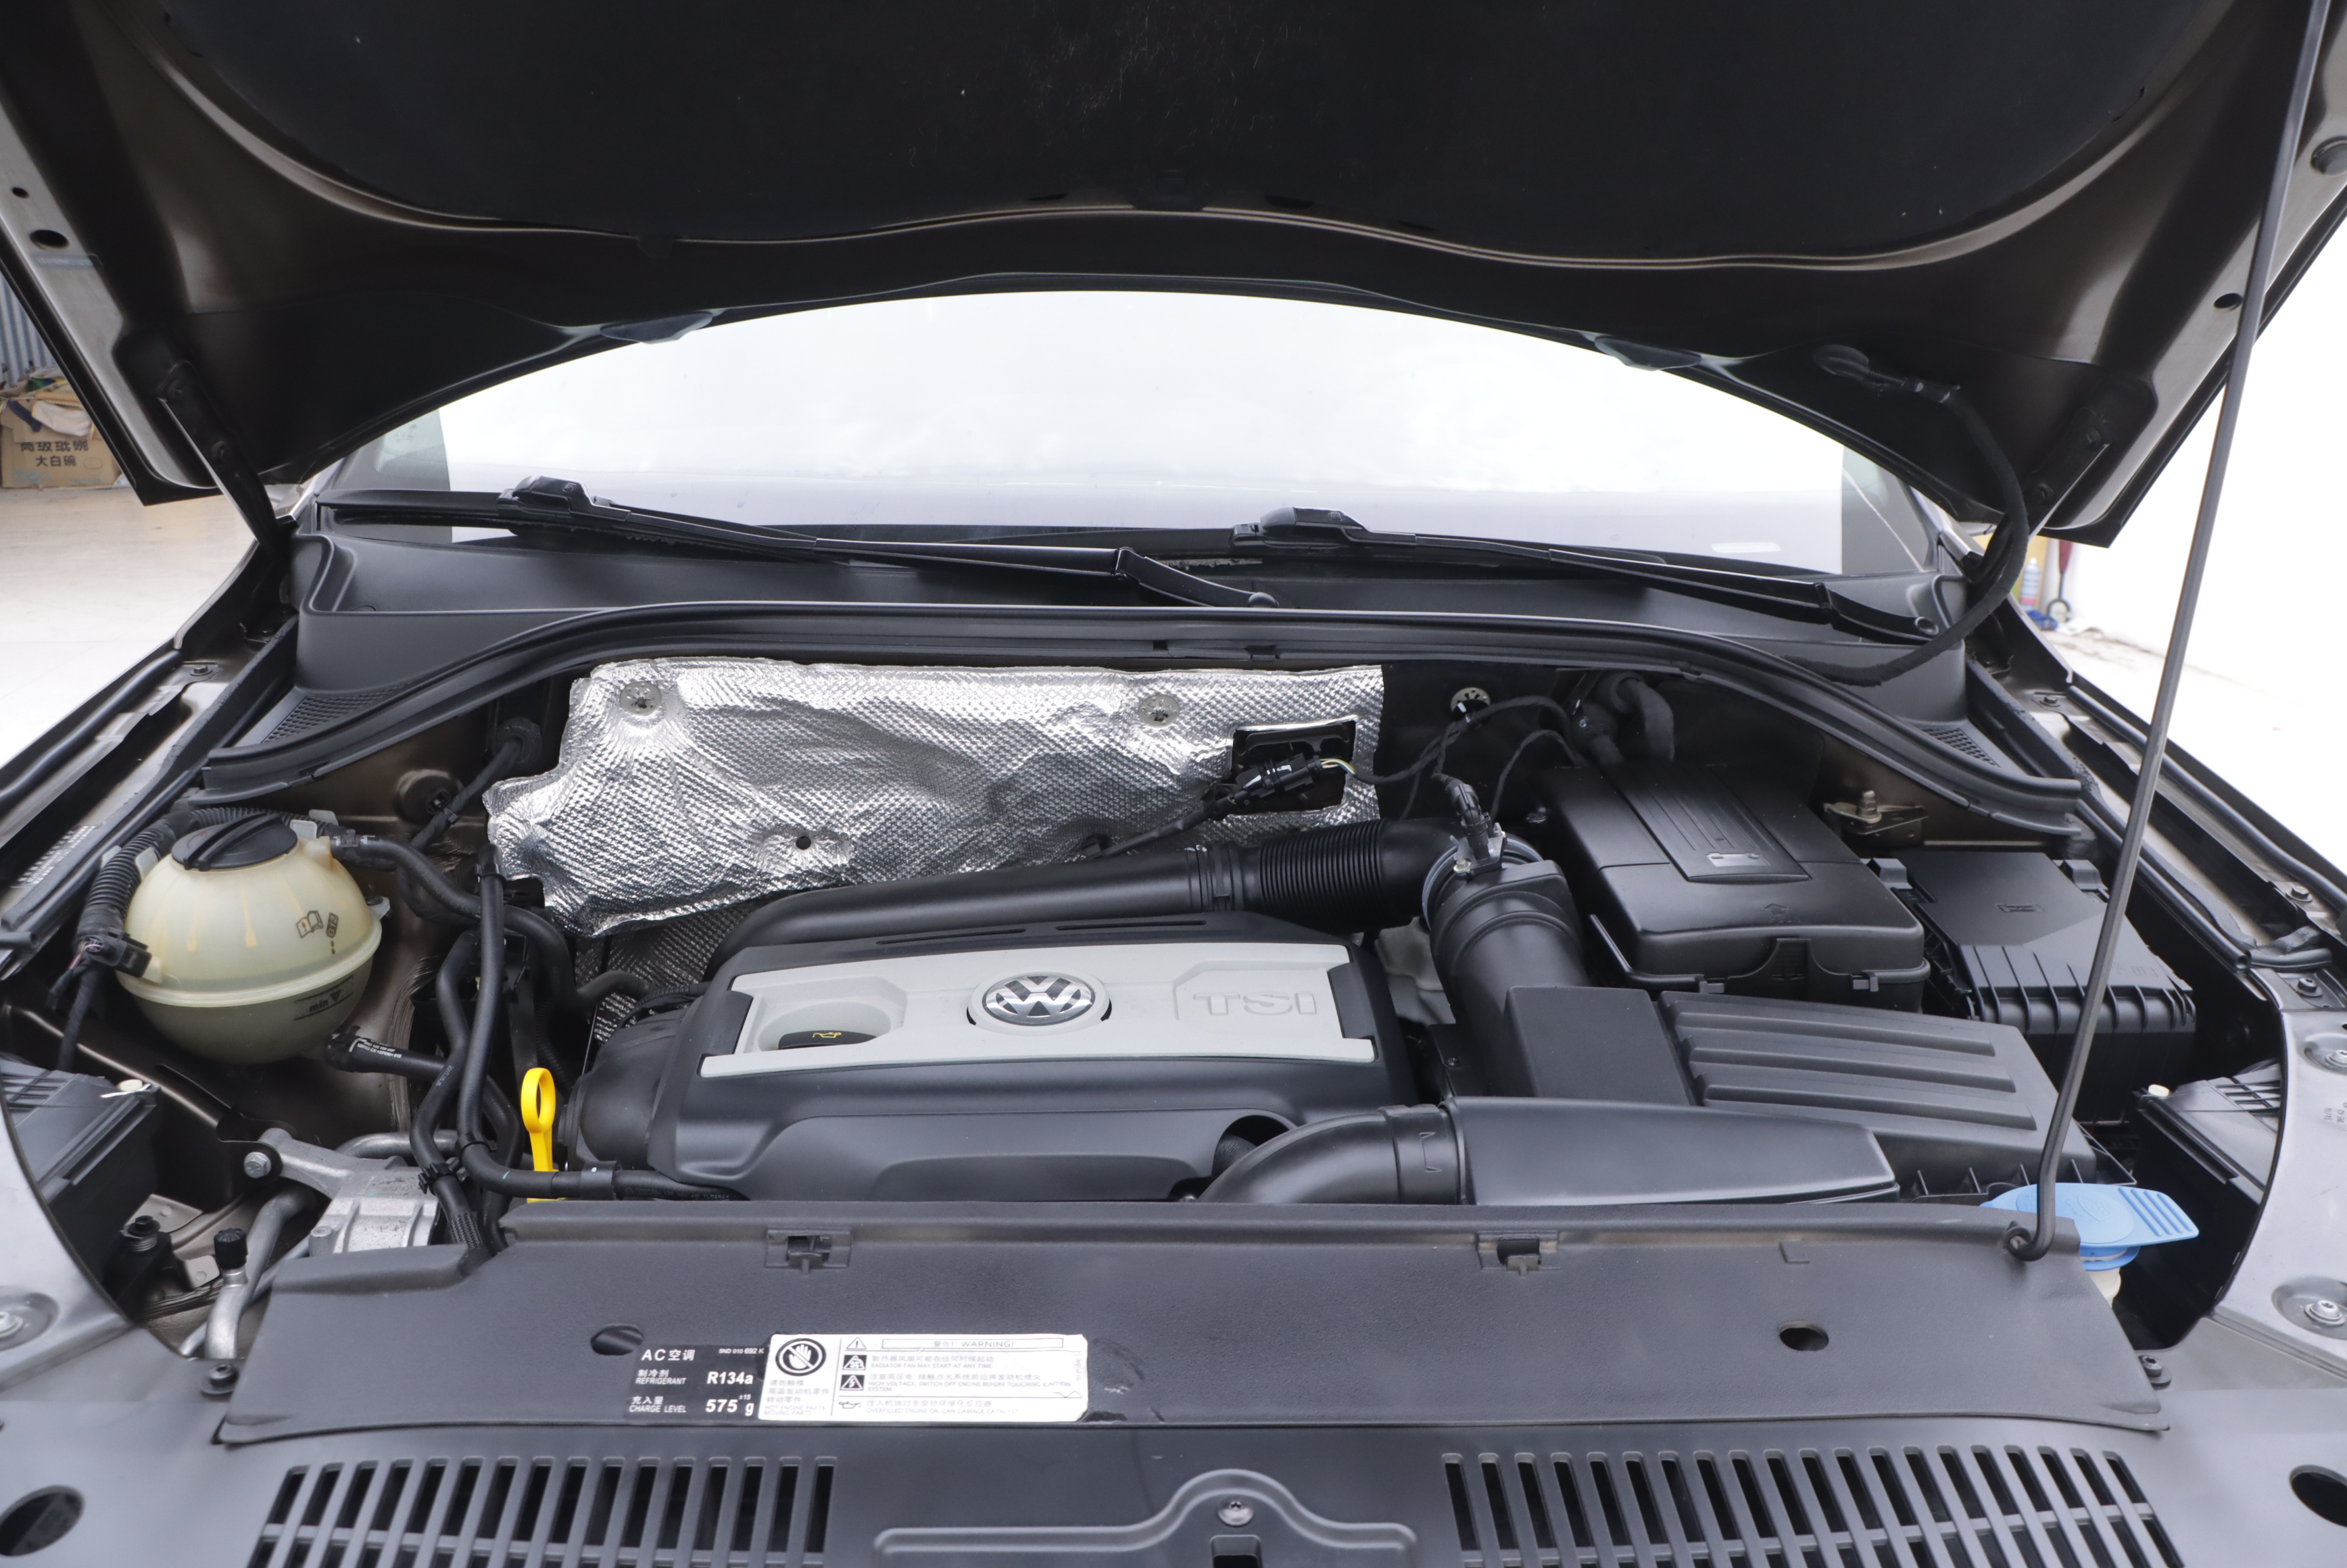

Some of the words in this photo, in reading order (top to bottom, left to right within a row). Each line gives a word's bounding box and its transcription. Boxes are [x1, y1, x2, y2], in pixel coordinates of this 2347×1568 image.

[36, 456, 76, 466] 大白碗
[309, 1000, 329, 1012] min
[1192, 991, 1317, 1015] TSI
[637, 1369, 669, 1377] 制冷剂
[706, 1371, 754, 1384] R134a
[631, 1396, 664, 1405] 充入量
[705, 1399, 738, 1413] 575
[745, 1402, 754, 1417] g
